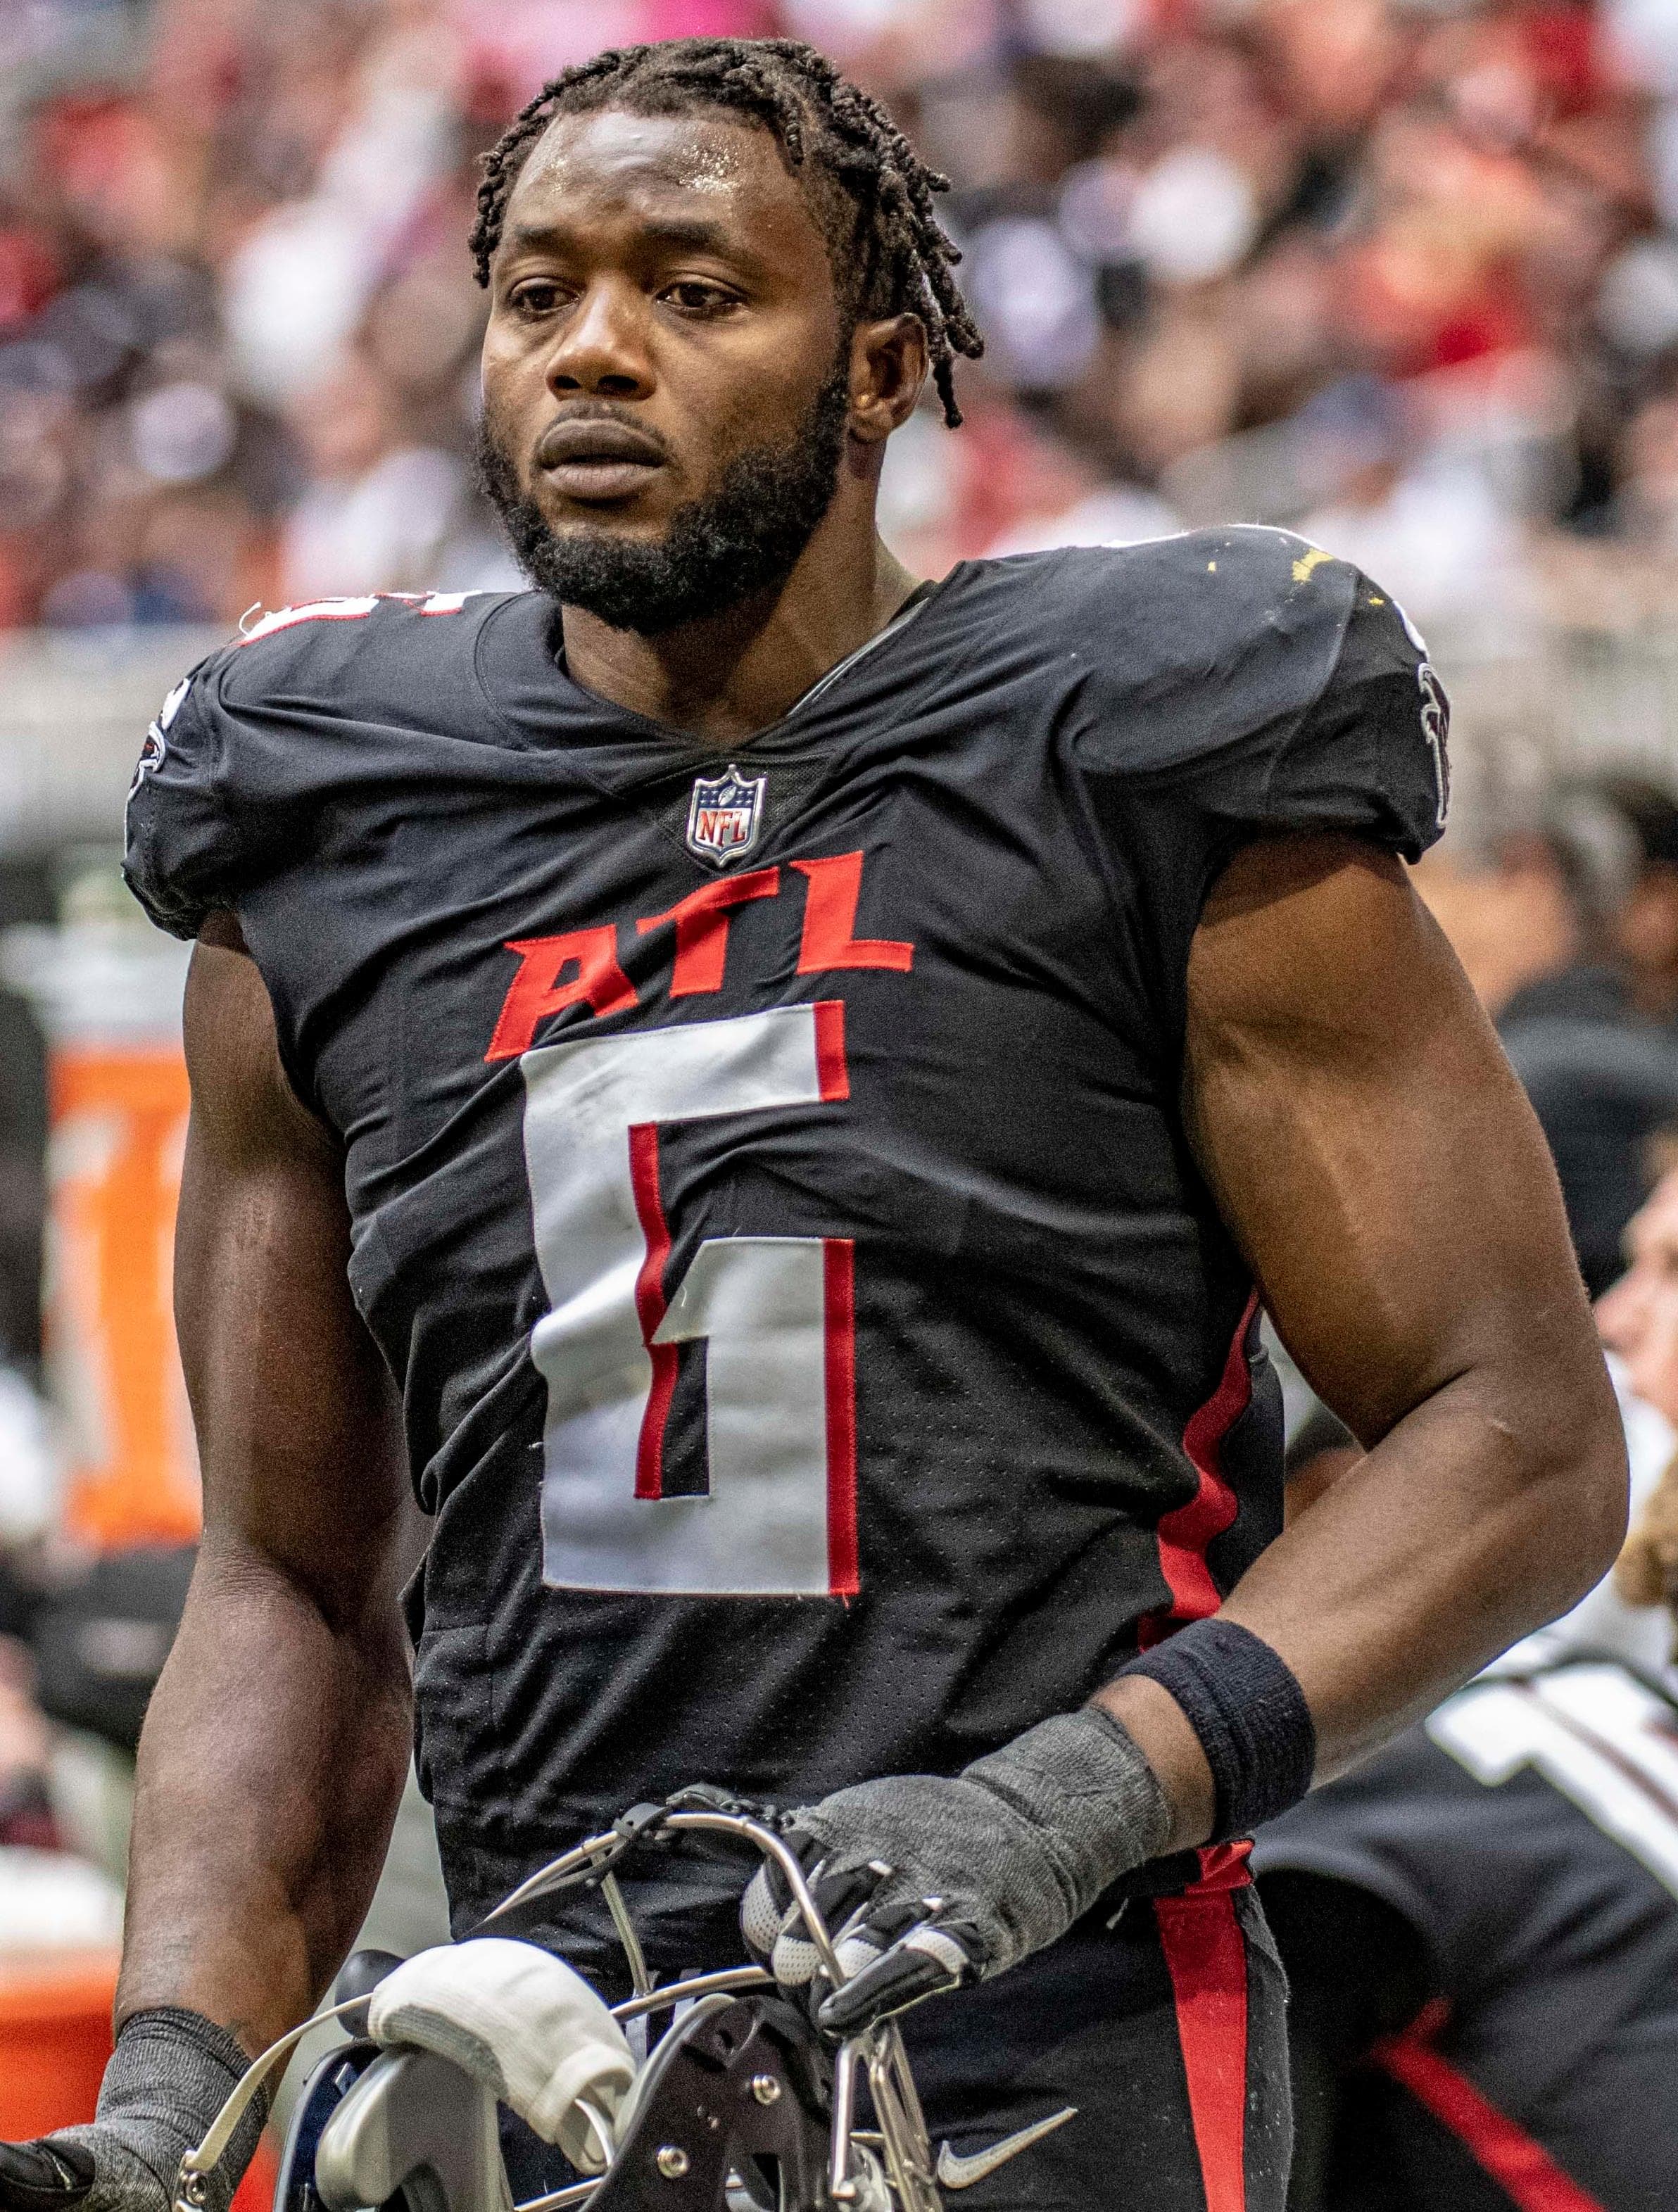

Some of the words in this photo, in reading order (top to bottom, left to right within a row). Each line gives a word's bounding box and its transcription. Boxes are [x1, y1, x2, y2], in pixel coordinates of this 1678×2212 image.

[698, 811, 747, 847] NFL
[485, 851, 914, 1062] ATL
[519, 999, 859, 1595] 6
